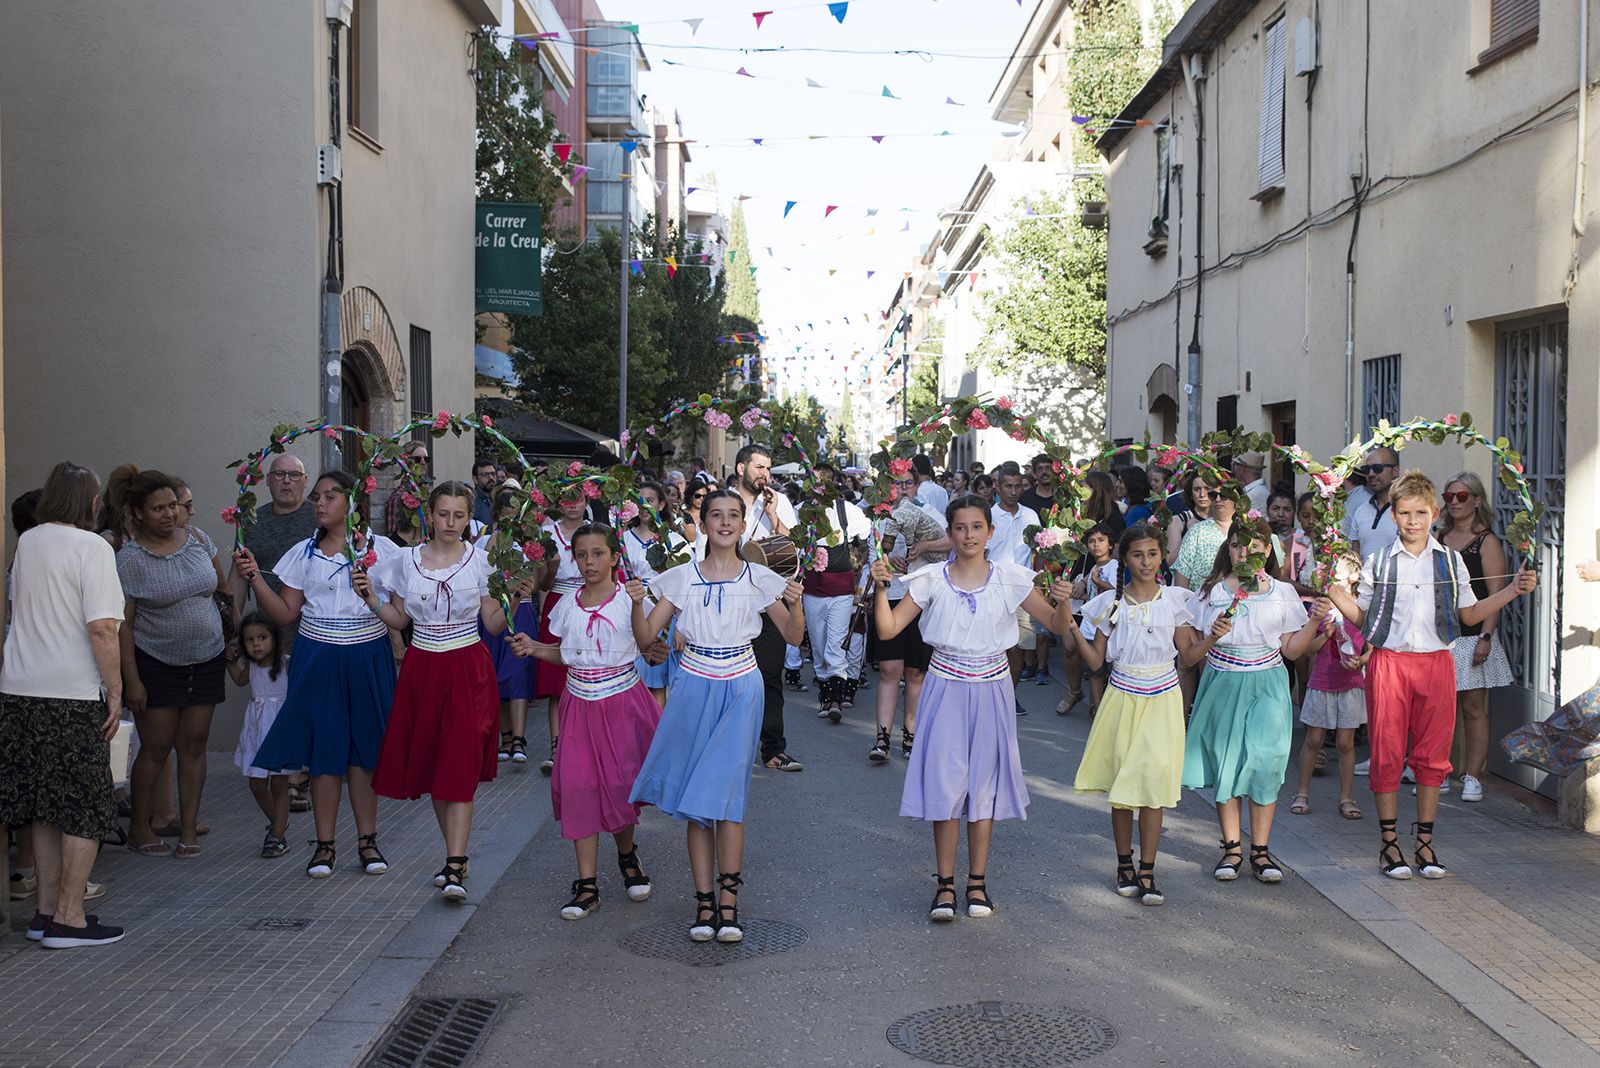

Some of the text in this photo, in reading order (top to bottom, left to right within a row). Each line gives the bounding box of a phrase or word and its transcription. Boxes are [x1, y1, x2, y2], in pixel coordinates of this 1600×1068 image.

[485, 212, 527, 228] Carrer
[475, 232, 539, 248] de la Creu
[488, 298, 530, 307] ARQUITECTA
